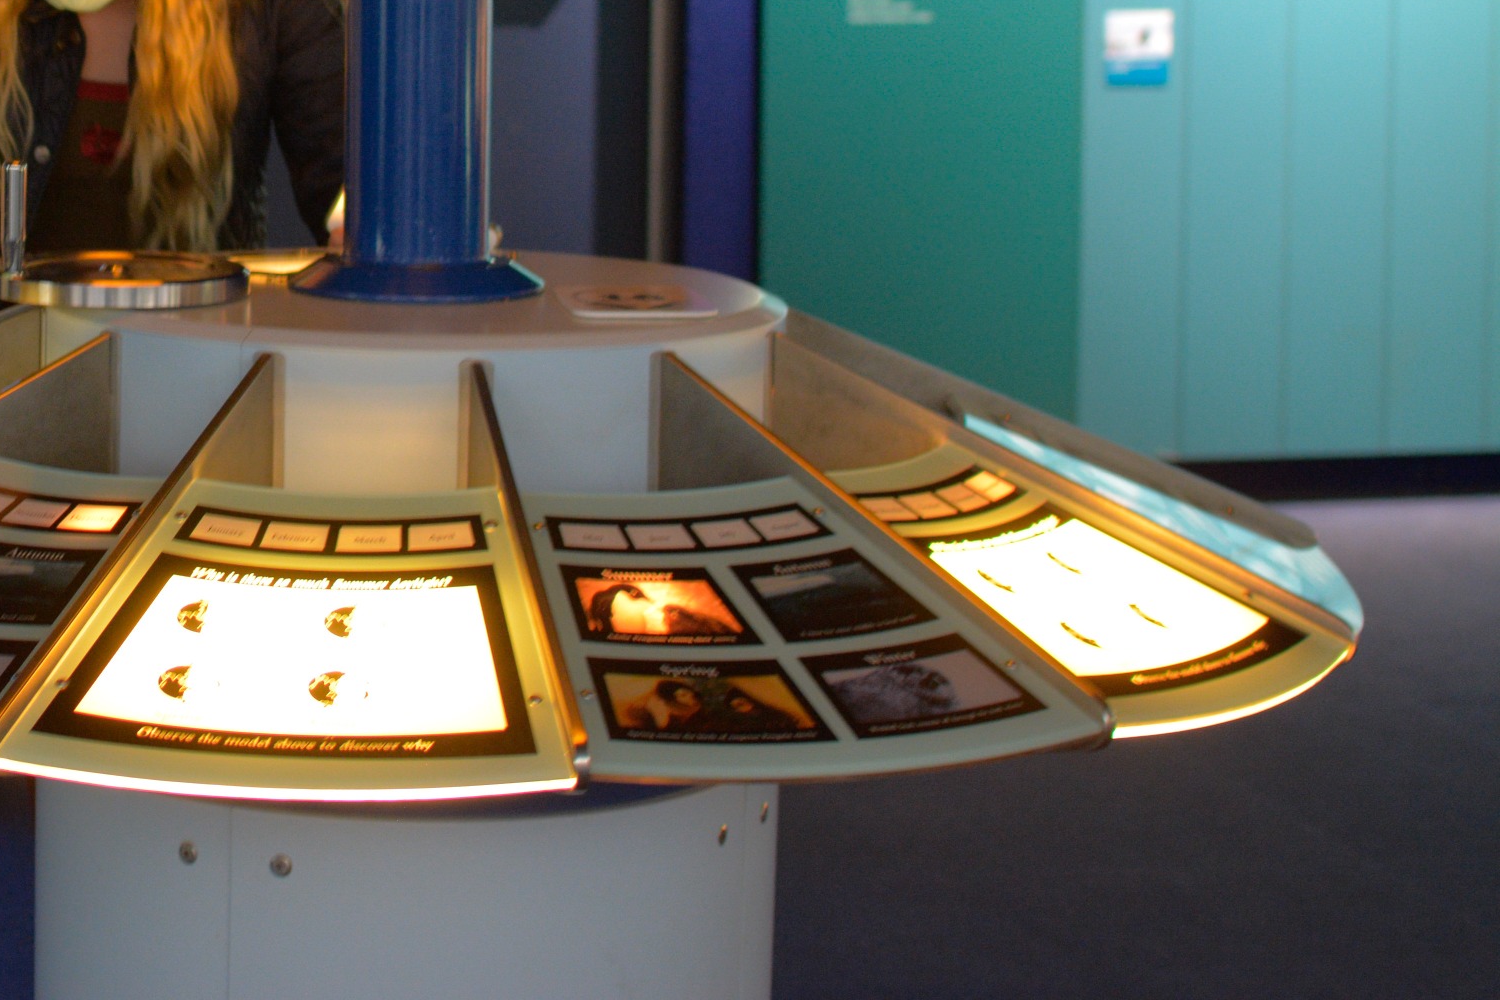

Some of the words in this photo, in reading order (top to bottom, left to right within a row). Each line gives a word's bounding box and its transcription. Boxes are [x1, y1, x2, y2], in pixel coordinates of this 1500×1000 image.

[6, 547, 65, 561] Autumn
[190, 566, 223, 583] Why
[292, 577, 330, 590] much
[601, 568, 674, 582] Summer
[136, 725, 194, 744] Observe
[198, 732, 222, 746] the
[224, 736, 272, 749] model
[339, 738, 400, 751] discover
[402, 738, 436, 753] why
